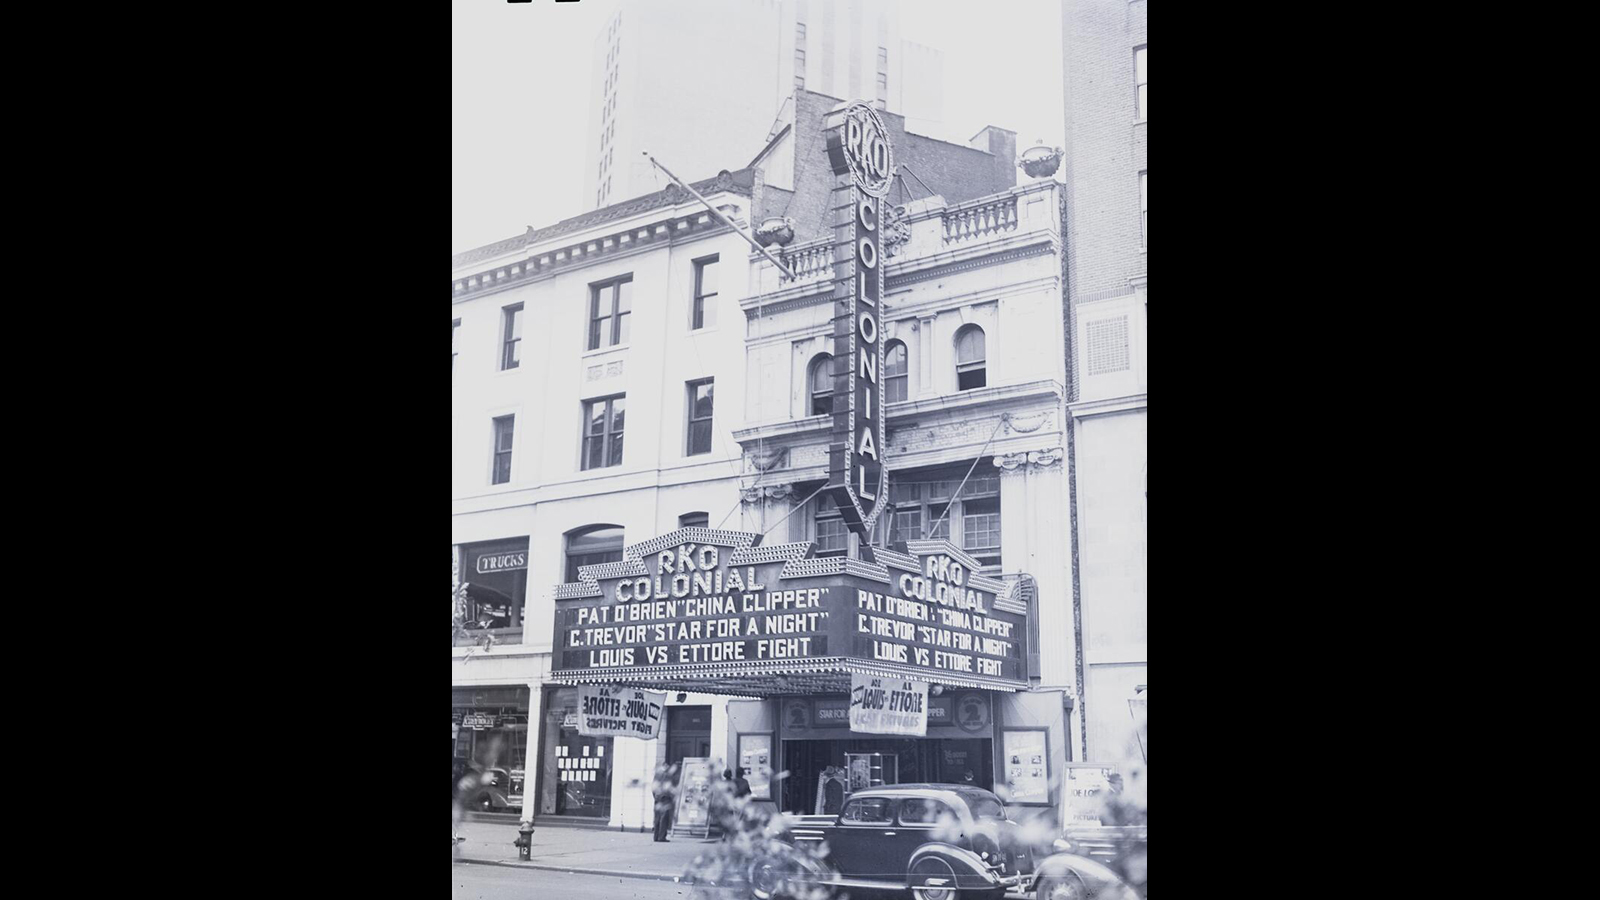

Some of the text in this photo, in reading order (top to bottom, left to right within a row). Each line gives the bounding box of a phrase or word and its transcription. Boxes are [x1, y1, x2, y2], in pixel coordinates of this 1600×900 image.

[847, 118, 888, 179] RKO
[858, 200, 878, 502] COLONIAL
[482, 553, 525, 570] TRUCKS
[657, 543, 719, 575] RKO
[926, 555, 963, 586] RKO
[615, 566, 766, 603] COLONIAL
[899, 573, 988, 615] COLONIAL
[578, 606, 611, 625] PAT
[614, 601, 677, 623] O'BRIEN
[743, 588, 829, 612] CLIPPER"
[858, 589, 883, 613] PAT
[886, 595, 929, 622] O'BRIEN
[973, 614, 1014, 638] CLIPPER"
[706, 618, 740, 639] FOR
[746, 618, 759, 636] A
[765, 612, 829, 634] NIGHT"
[590, 637, 811, 668] LOUIS VS ETTORE FIGHT
[874, 640, 1003, 677] LOUIS VS ETTORE FIGHT
[953, 634, 972, 652] FOR
[862, 688, 886, 710] LOUIS
[889, 690, 923, 713] ETTORE
[927, 707, 945, 717] PPER
[965, 704, 981, 721] 2
[521, 847, 528, 855] 12
